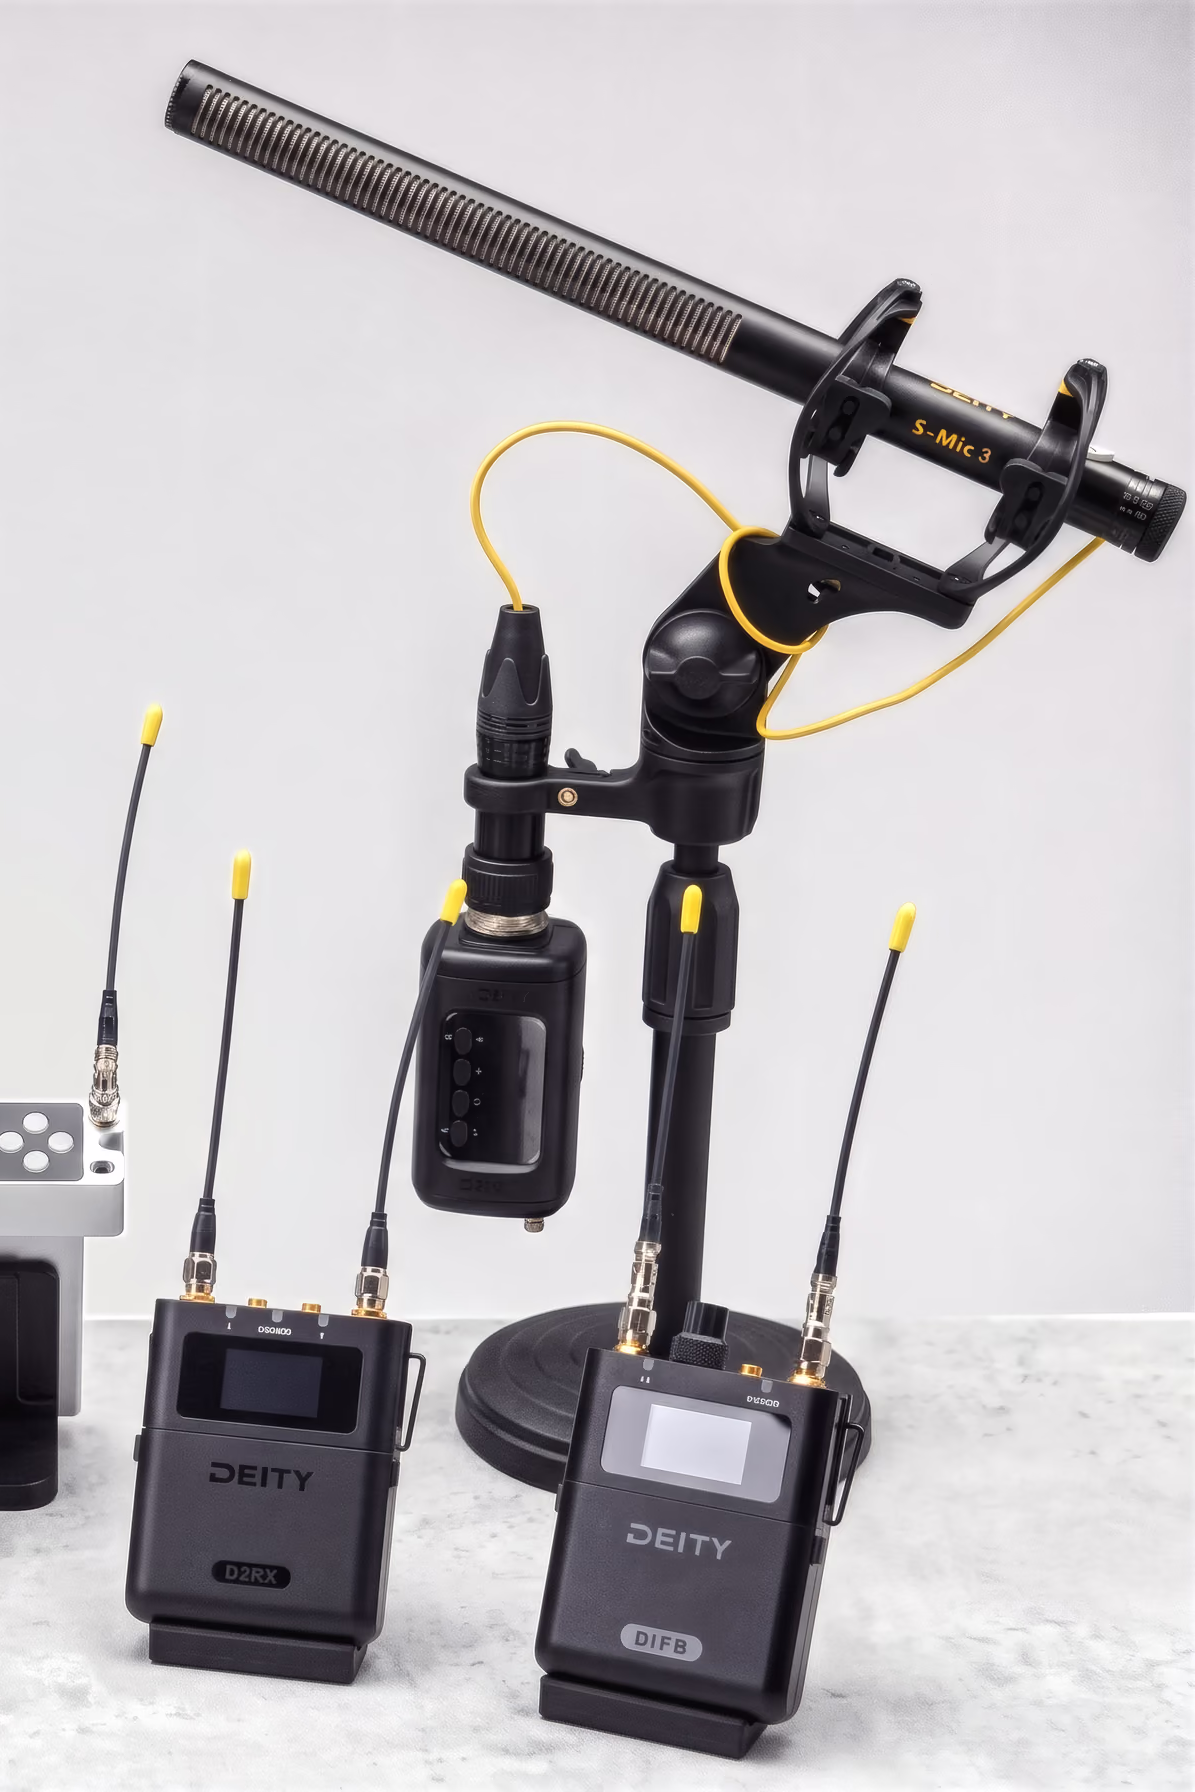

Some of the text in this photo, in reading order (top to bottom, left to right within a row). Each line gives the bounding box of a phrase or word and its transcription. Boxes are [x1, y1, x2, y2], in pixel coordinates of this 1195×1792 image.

[911, 419, 992, 464] S-Mic 3
[208, 1461, 315, 1492] DEITY
[626, 1522, 732, 1560] DEITY
[225, 1564, 278, 1585] D2RX
[634, 1629, 688, 1655] DIFB
